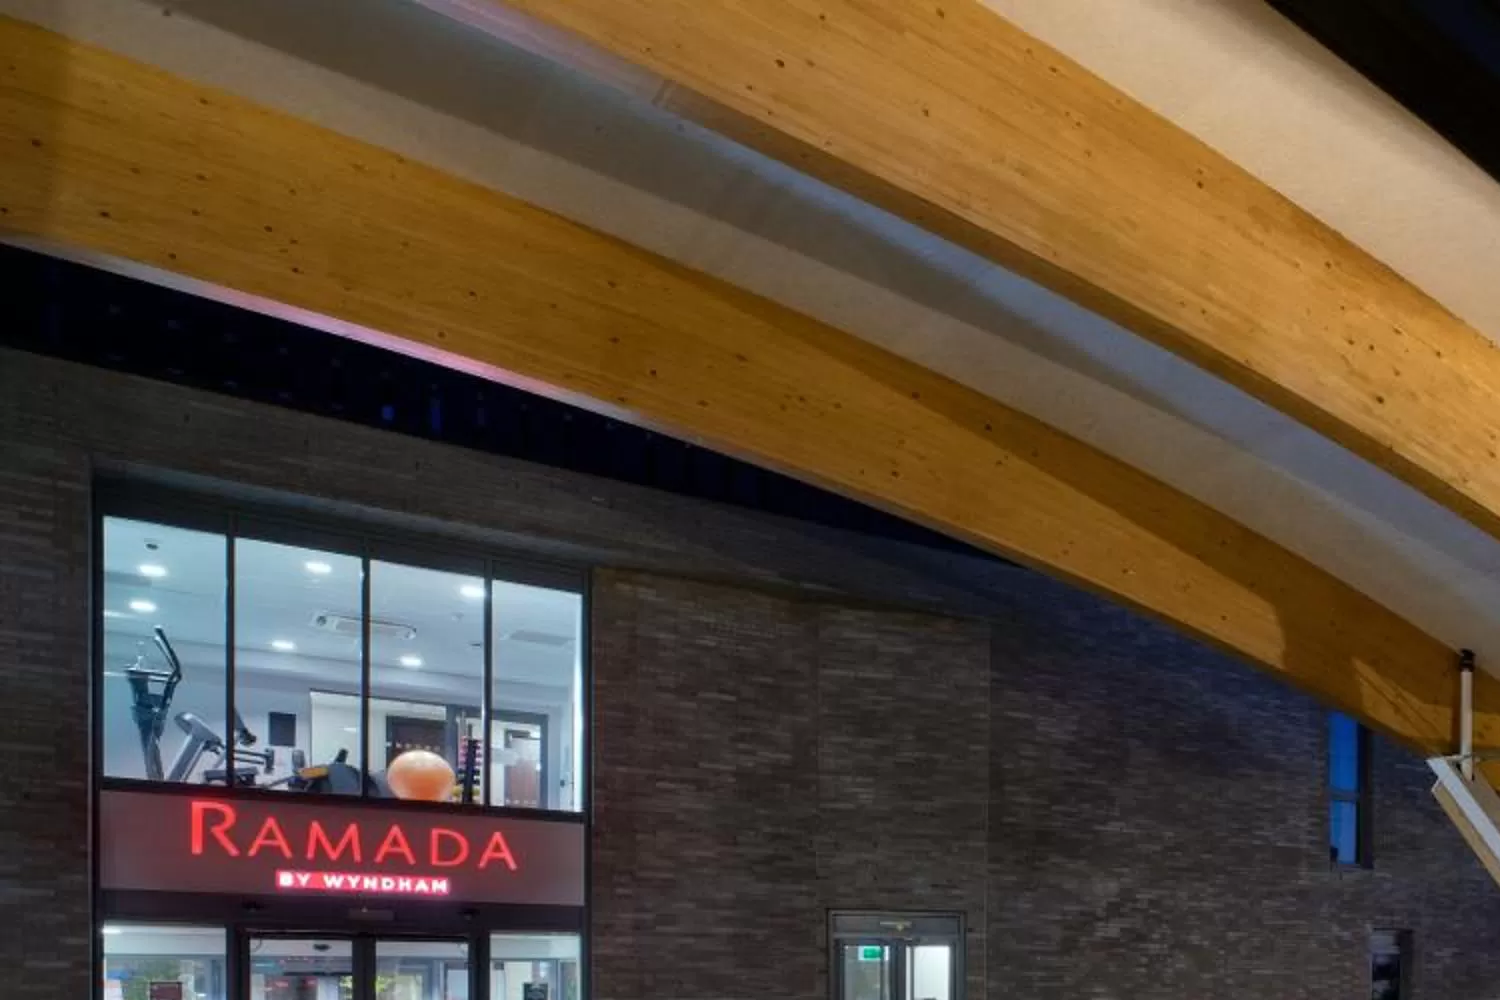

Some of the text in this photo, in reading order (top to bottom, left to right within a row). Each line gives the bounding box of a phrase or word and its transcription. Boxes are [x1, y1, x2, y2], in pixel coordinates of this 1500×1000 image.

[191, 801, 518, 871] RAMADA
[279, 874, 448, 893] BY WYNDHAM
